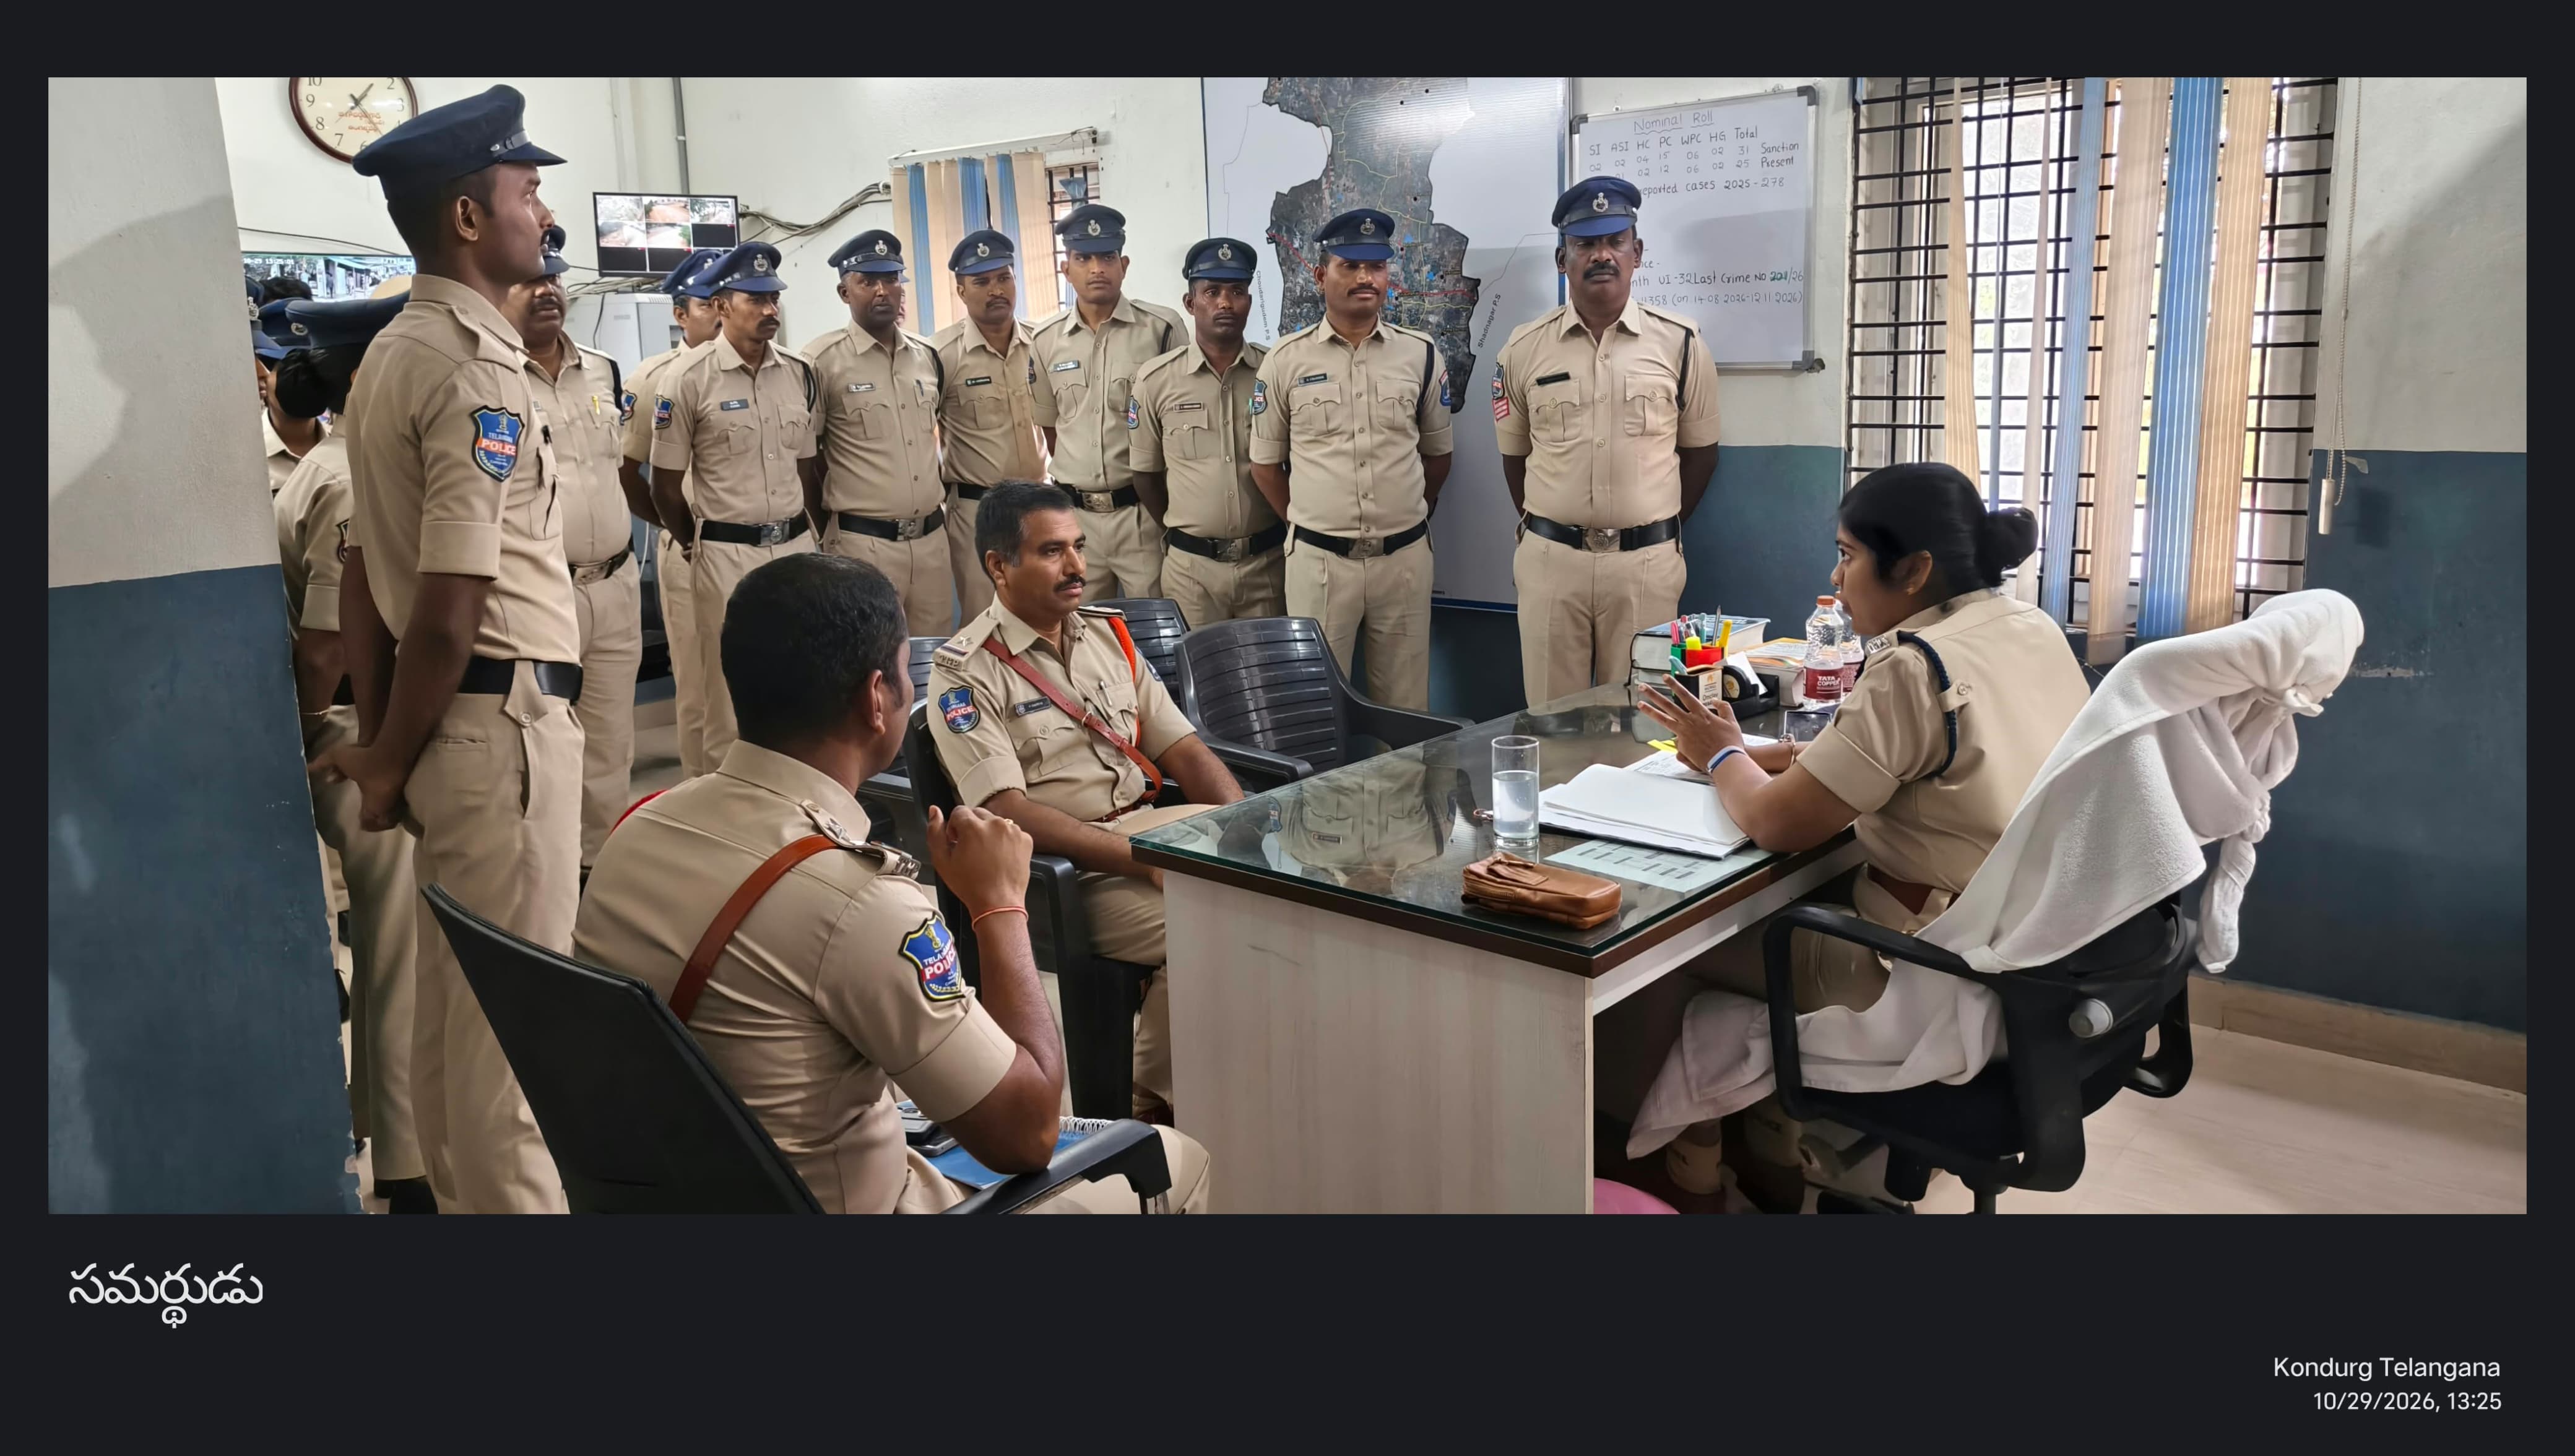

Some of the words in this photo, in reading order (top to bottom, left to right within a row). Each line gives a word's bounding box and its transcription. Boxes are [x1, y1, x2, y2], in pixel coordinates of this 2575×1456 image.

[387, 77, 395, 90] 2
[306, 94, 315, 107] 9
[397, 98, 405, 112] 3
[316, 116, 325, 130] 8
[1634, 114, 1682, 132] Nominal
[1693, 110, 1713, 123] Roll
[334, 133, 344, 146] 7
[1589, 144, 1601, 155] SI
[1611, 141, 1629, 152] ASI
[1637, 140, 1650, 150] HC
[1660, 136, 1672, 148] PC
[1681, 133, 1702, 145] WPC
[1710, 131, 1726, 142] HG
[1734, 125, 1757, 139] Total
[1589, 163, 1601, 172] 02
[1615, 159, 1625, 167] 02
[1660, 152, 1670, 160] 15
[1687, 152, 1699, 160] 06
[1712, 147, 1724, 155] 02
[1738, 145, 1749, 155] 31
[1761, 142, 1799, 154] Sanction
[1638, 168, 1650, 176] 02
[1660, 165, 1669, 173] 12
[1687, 165, 1699, 173] 06
[1713, 162, 1724, 170] 02
[1736, 159, 1749, 168] 25
[1761, 155, 1793, 169] Present
[1686, 180, 1715, 192] cases
[1632, 275, 1649, 287] nth
[1721, 273, 1751, 283] Crime
[1478, 307, 1496, 348] Shadnagar
[1492, 293, 1501, 306] P.S
[481, 437, 516, 455] POLICE
[946, 705, 976, 720] POLICE
[924, 944, 956, 979] POLICE
